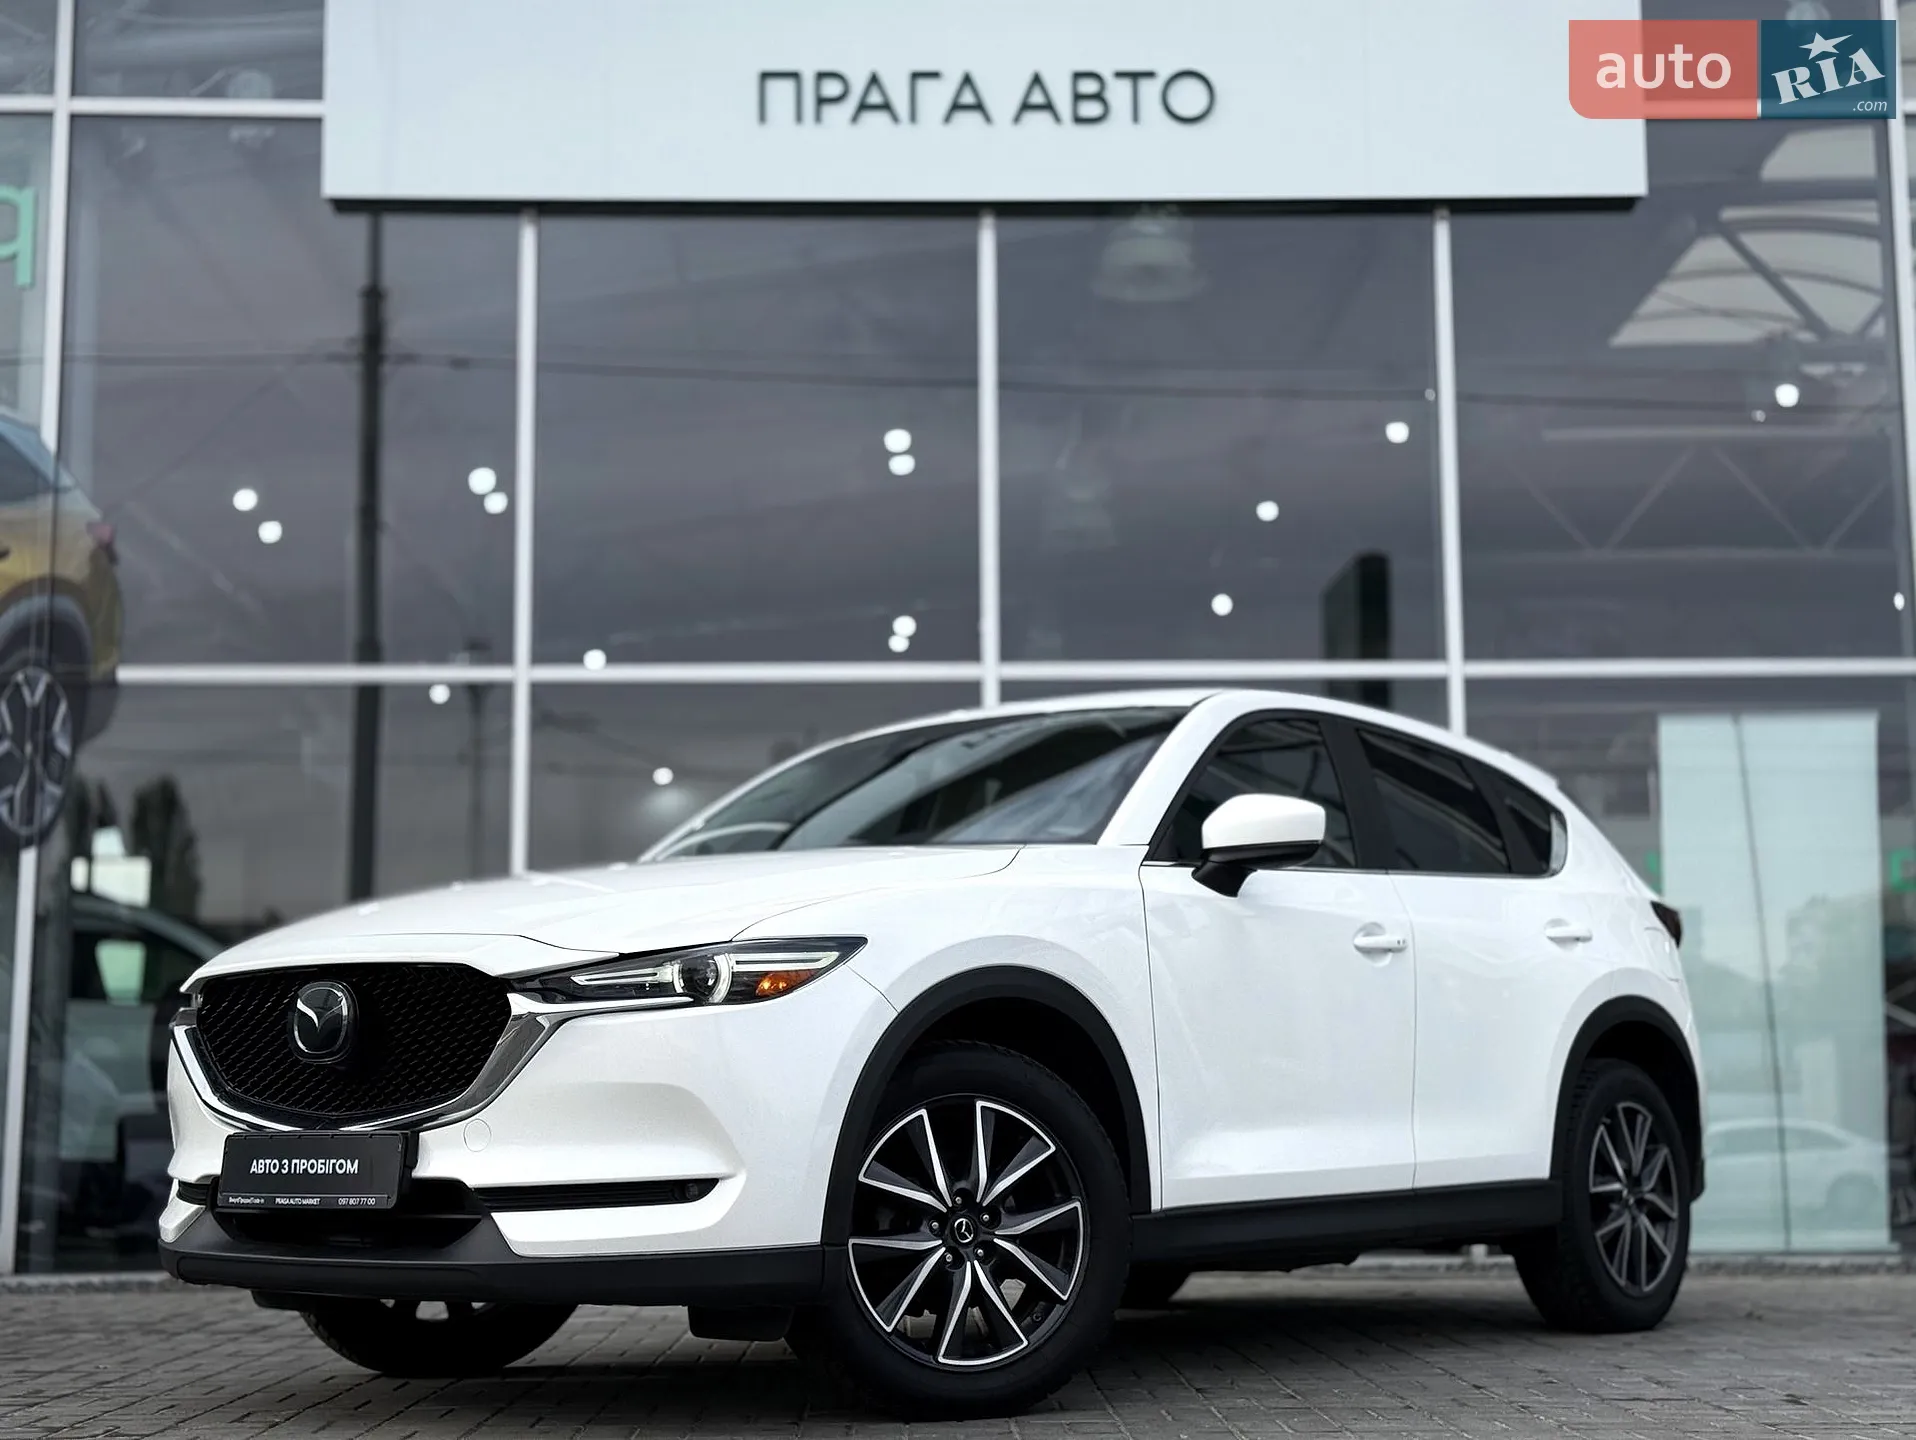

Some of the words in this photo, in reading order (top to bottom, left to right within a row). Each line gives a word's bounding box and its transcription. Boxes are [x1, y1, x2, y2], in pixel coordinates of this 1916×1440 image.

[757, 69, 993, 126] ПРАГА
[1011, 69, 1216, 126] АВТО
[249, 1159, 280, 1174] АВТО
[291, 1159, 359, 1174] ПРОБІГОМ
[360, 1197, 367, 1205] 77
[367, 1197, 376, 1205] 00
